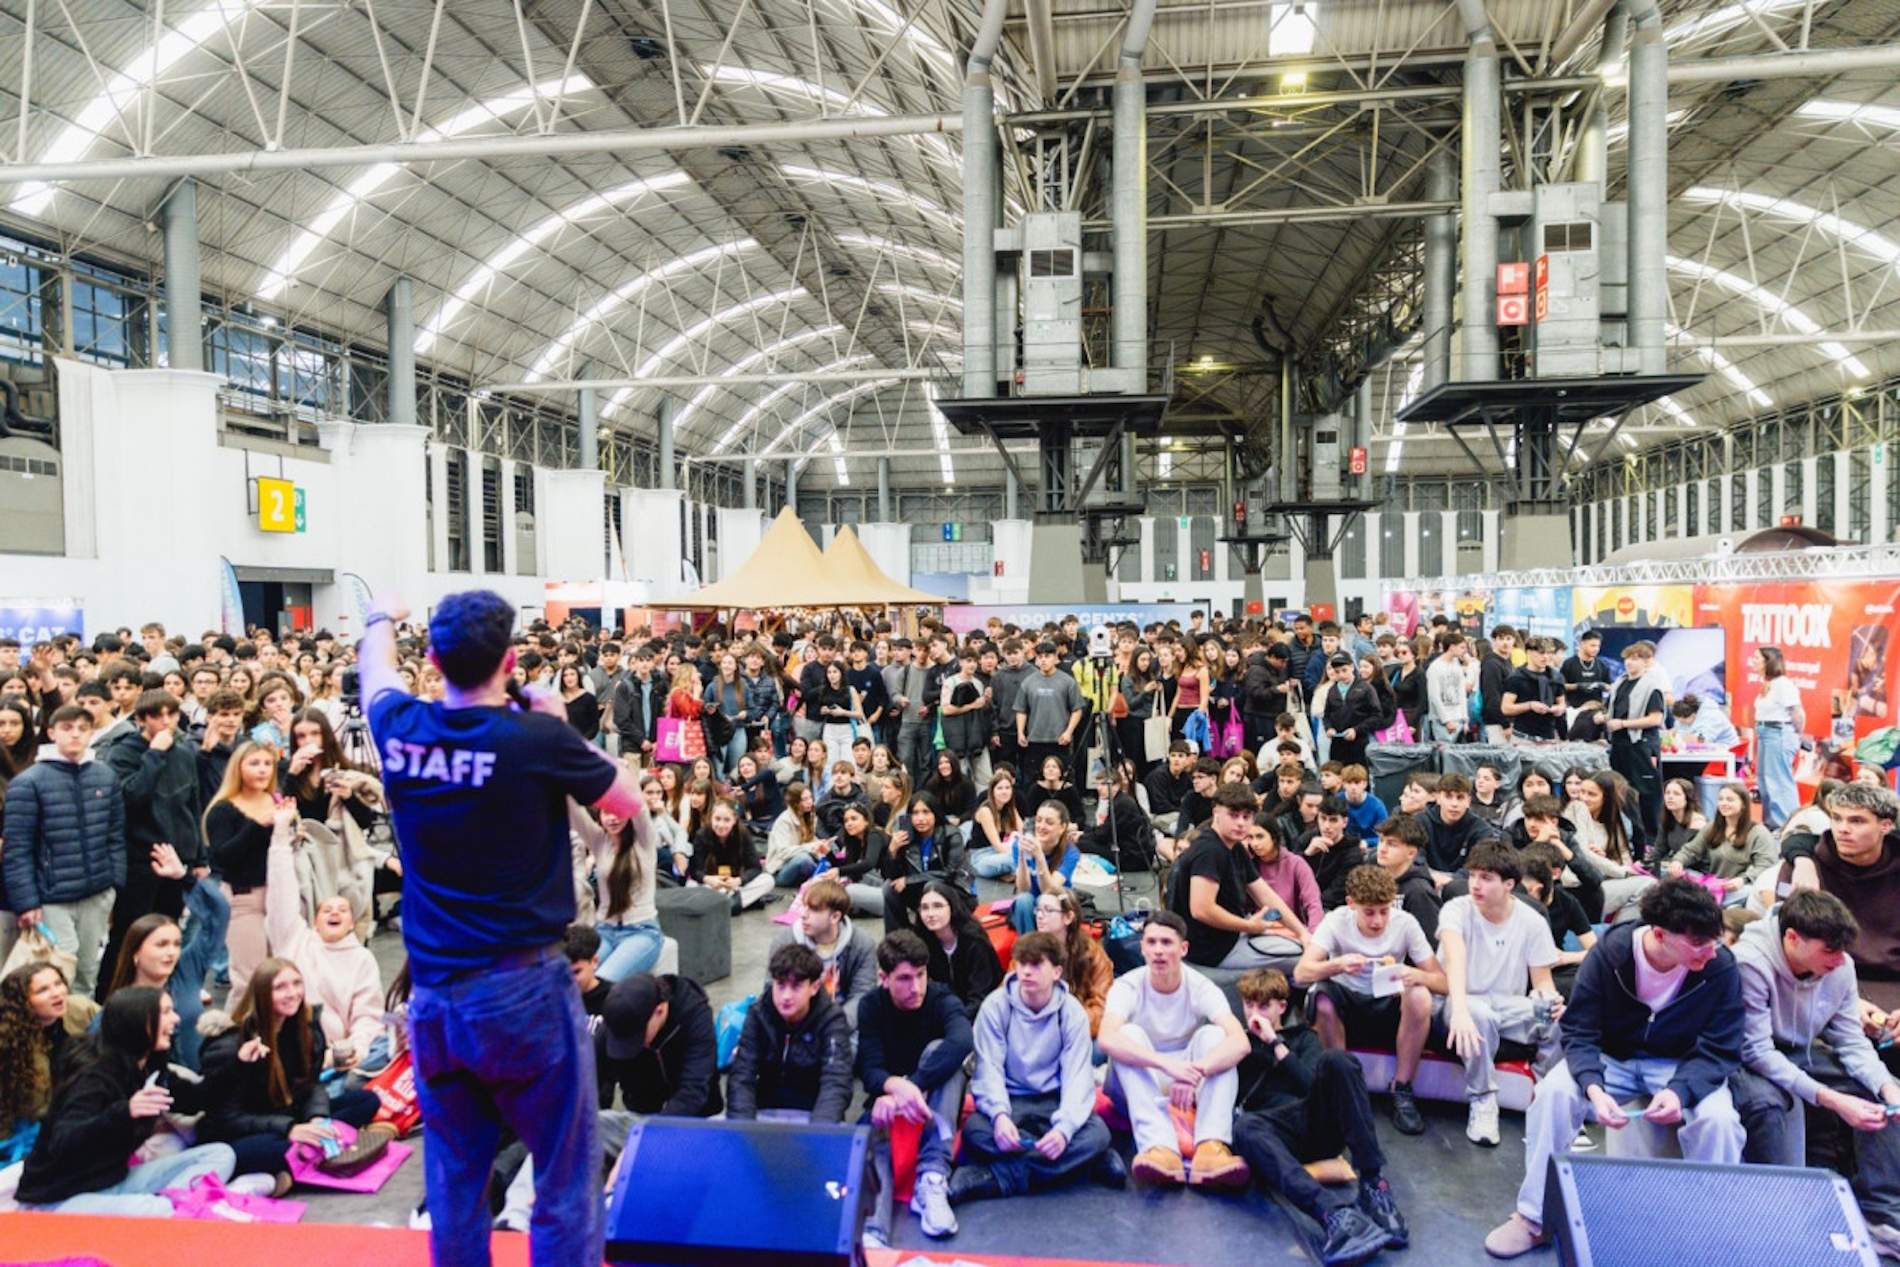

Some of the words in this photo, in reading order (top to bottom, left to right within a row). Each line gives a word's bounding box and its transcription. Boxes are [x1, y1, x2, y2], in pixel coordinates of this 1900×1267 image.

[270, 489, 285, 521] 2
[1741, 603, 1832, 648] TATTOOX
[385, 738, 496, 787] STAFF
